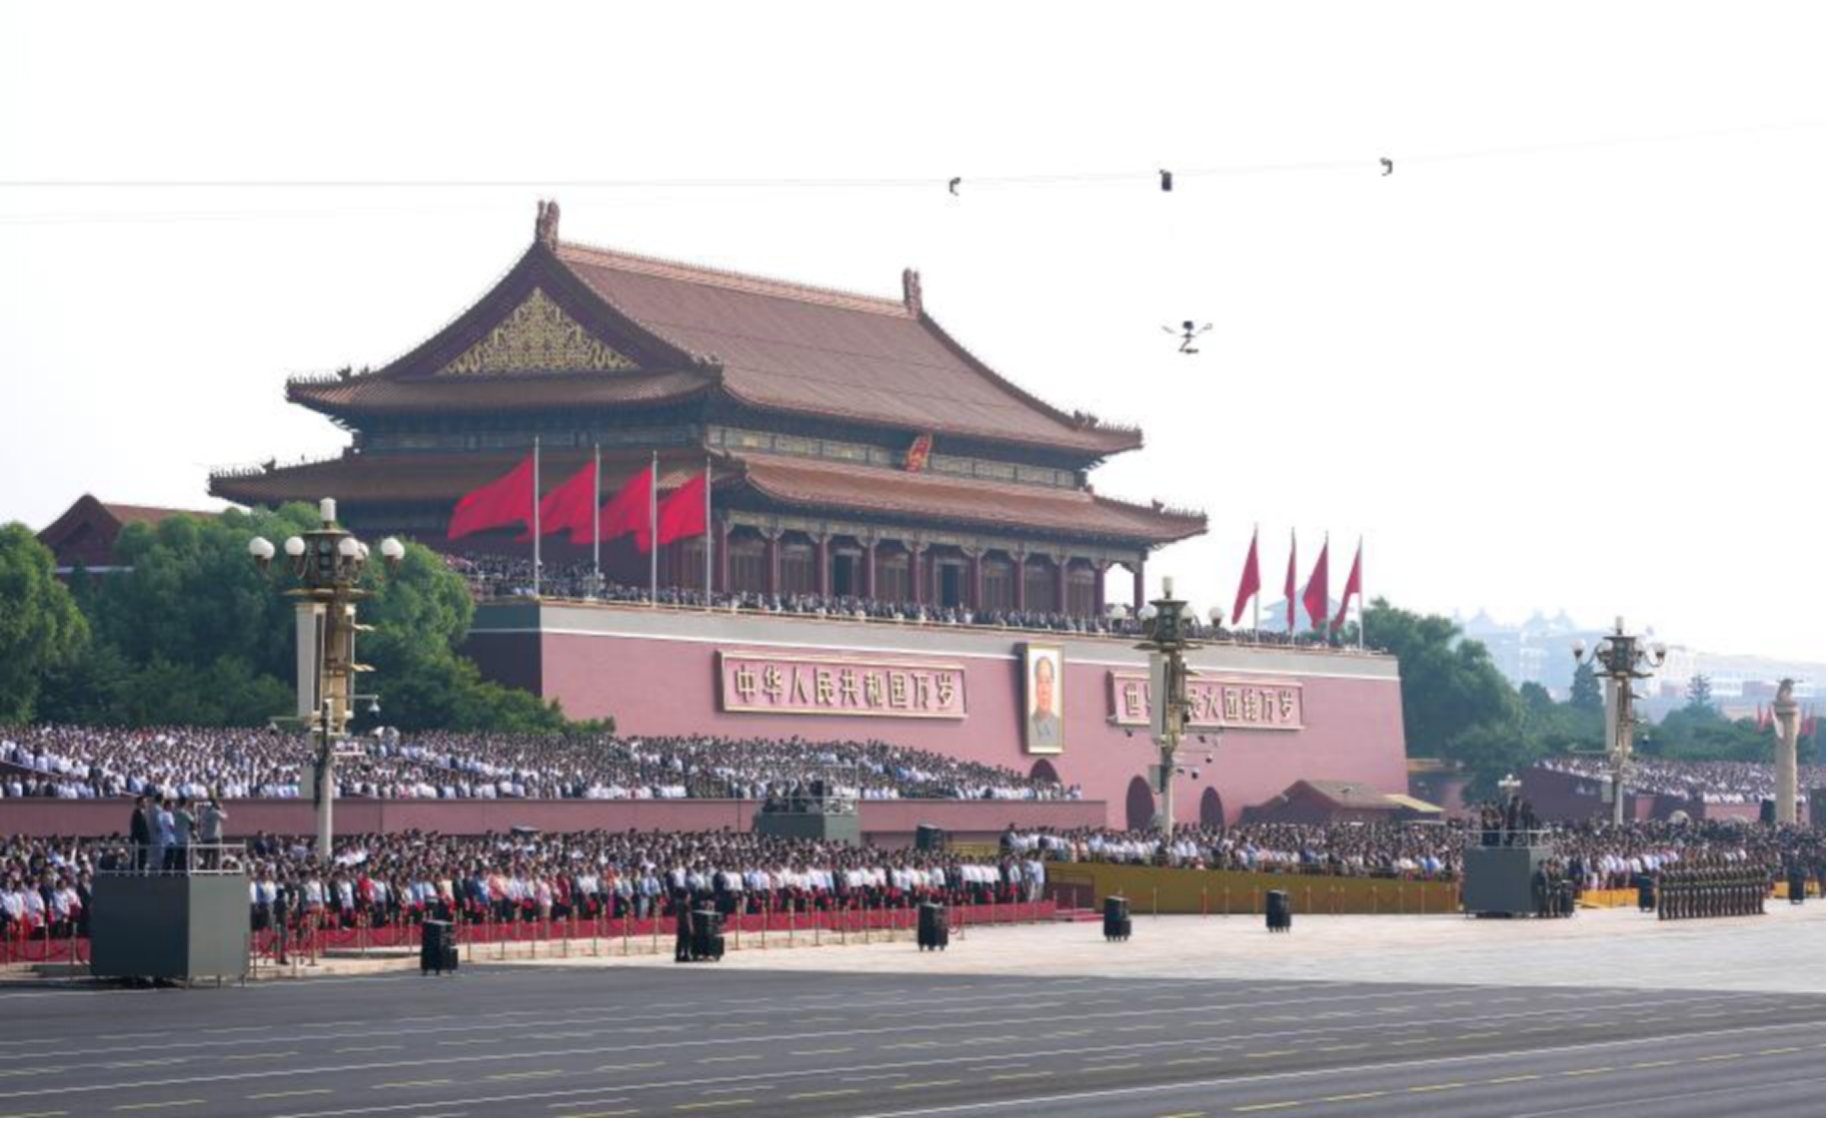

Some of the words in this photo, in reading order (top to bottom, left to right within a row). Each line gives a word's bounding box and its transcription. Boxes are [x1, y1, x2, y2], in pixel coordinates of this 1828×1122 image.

[735, 664, 955, 710] 中华人民共和国万岁
[1124, 682, 1295, 723] 世民大团结万岁
